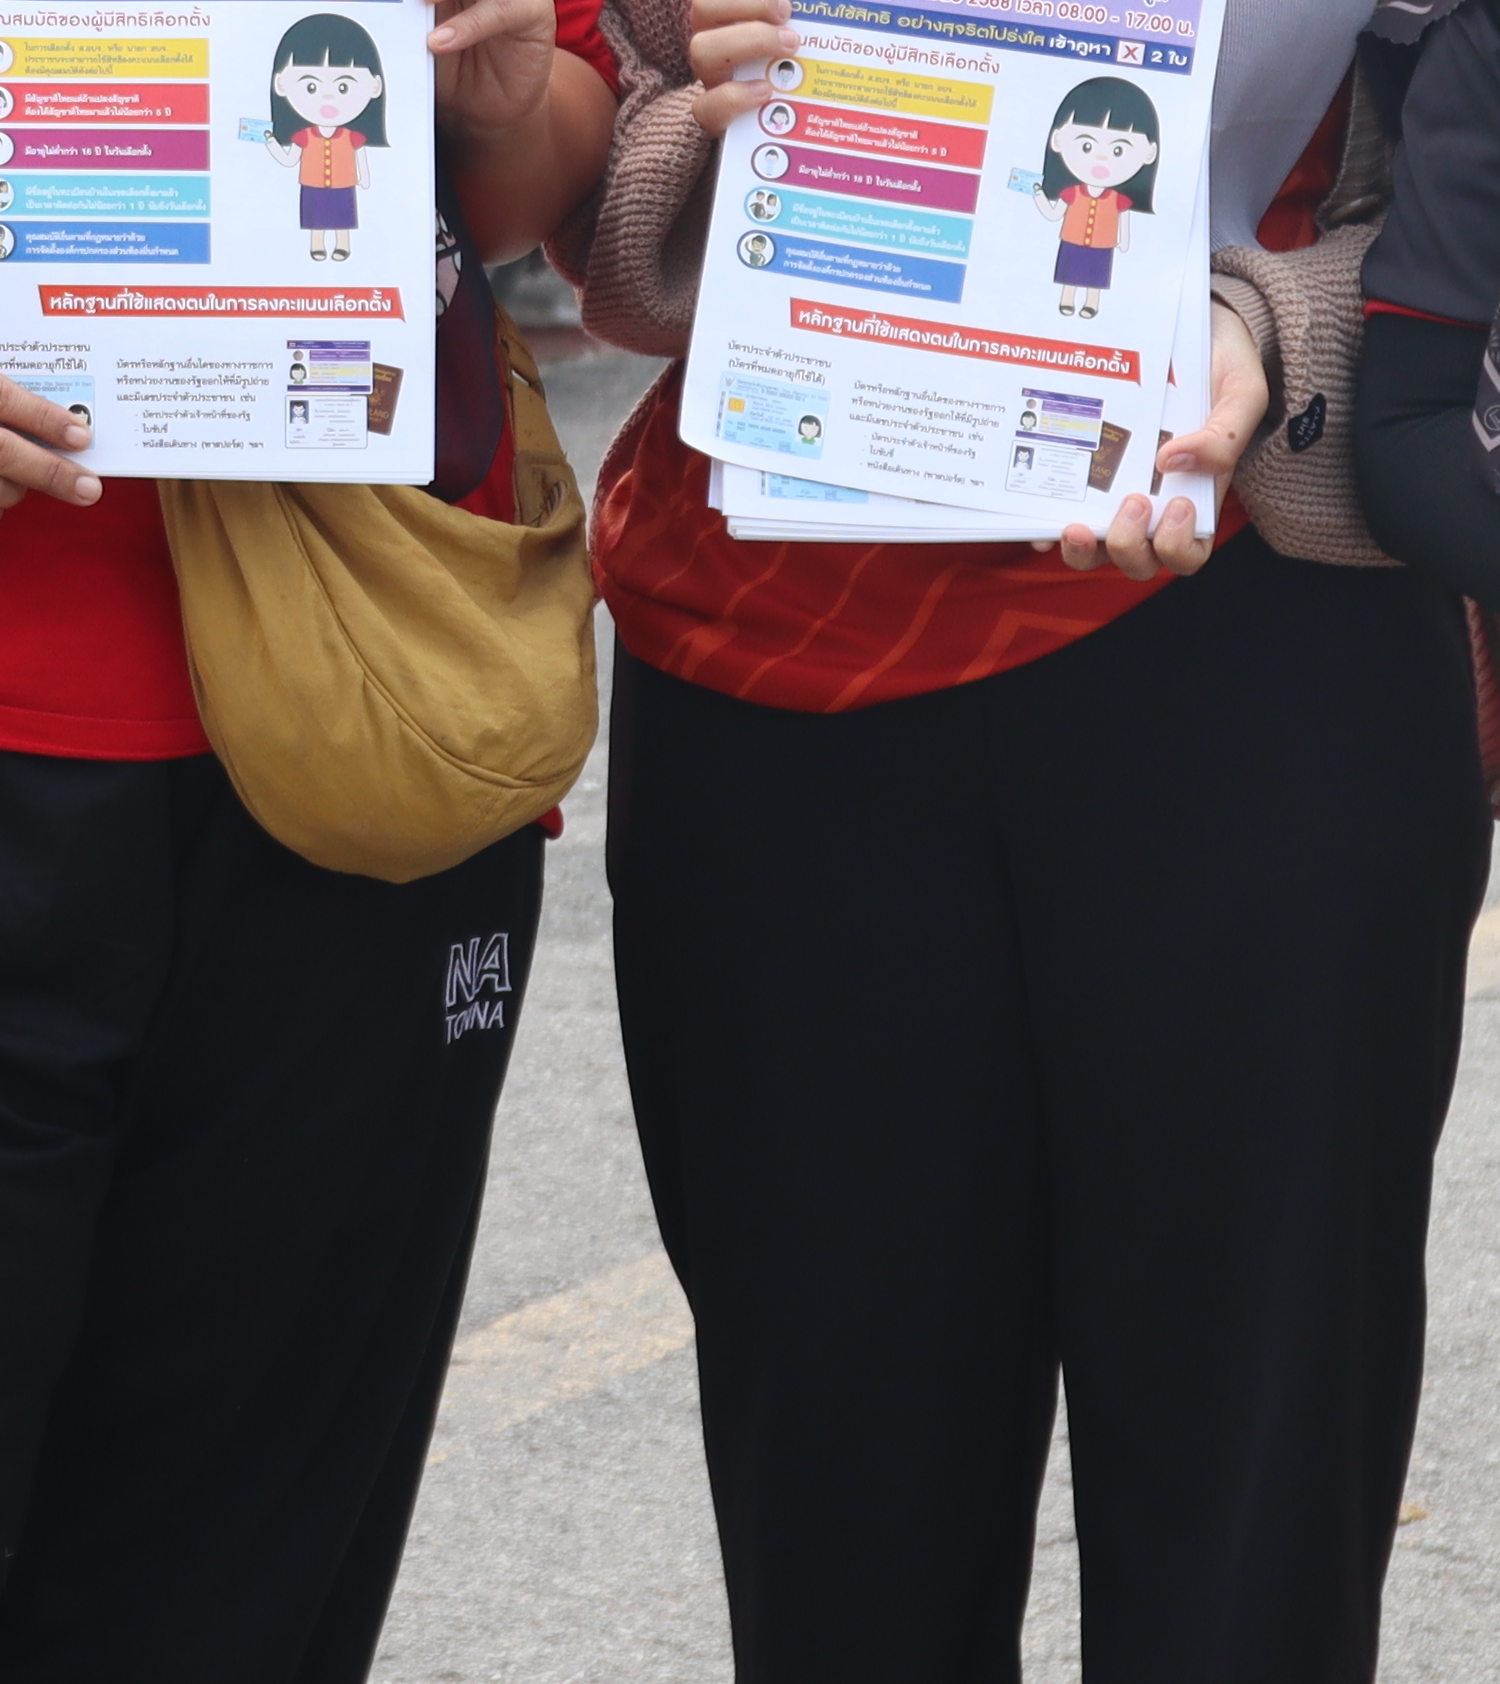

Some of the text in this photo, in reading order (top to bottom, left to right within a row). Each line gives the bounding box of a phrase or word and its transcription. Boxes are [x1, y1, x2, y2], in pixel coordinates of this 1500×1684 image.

[896, 14, 1046, 45] อย่างสุจริตโปร่งใส
[1049, 34, 1111, 55] เข้าคูหา
[1151, 50, 1163, 62] 2
[1169, 50, 1187, 66] ใบ
[1057, 1, 1108, 23] 08.00
[1126, 9, 1175, 33] 17.00
[1177, 19, 1196, 37] น.
[799, 33, 999, 72] สมบัติของผู้มีสิทธิเลือกตั้ง
[446, 932, 512, 1008] NA
